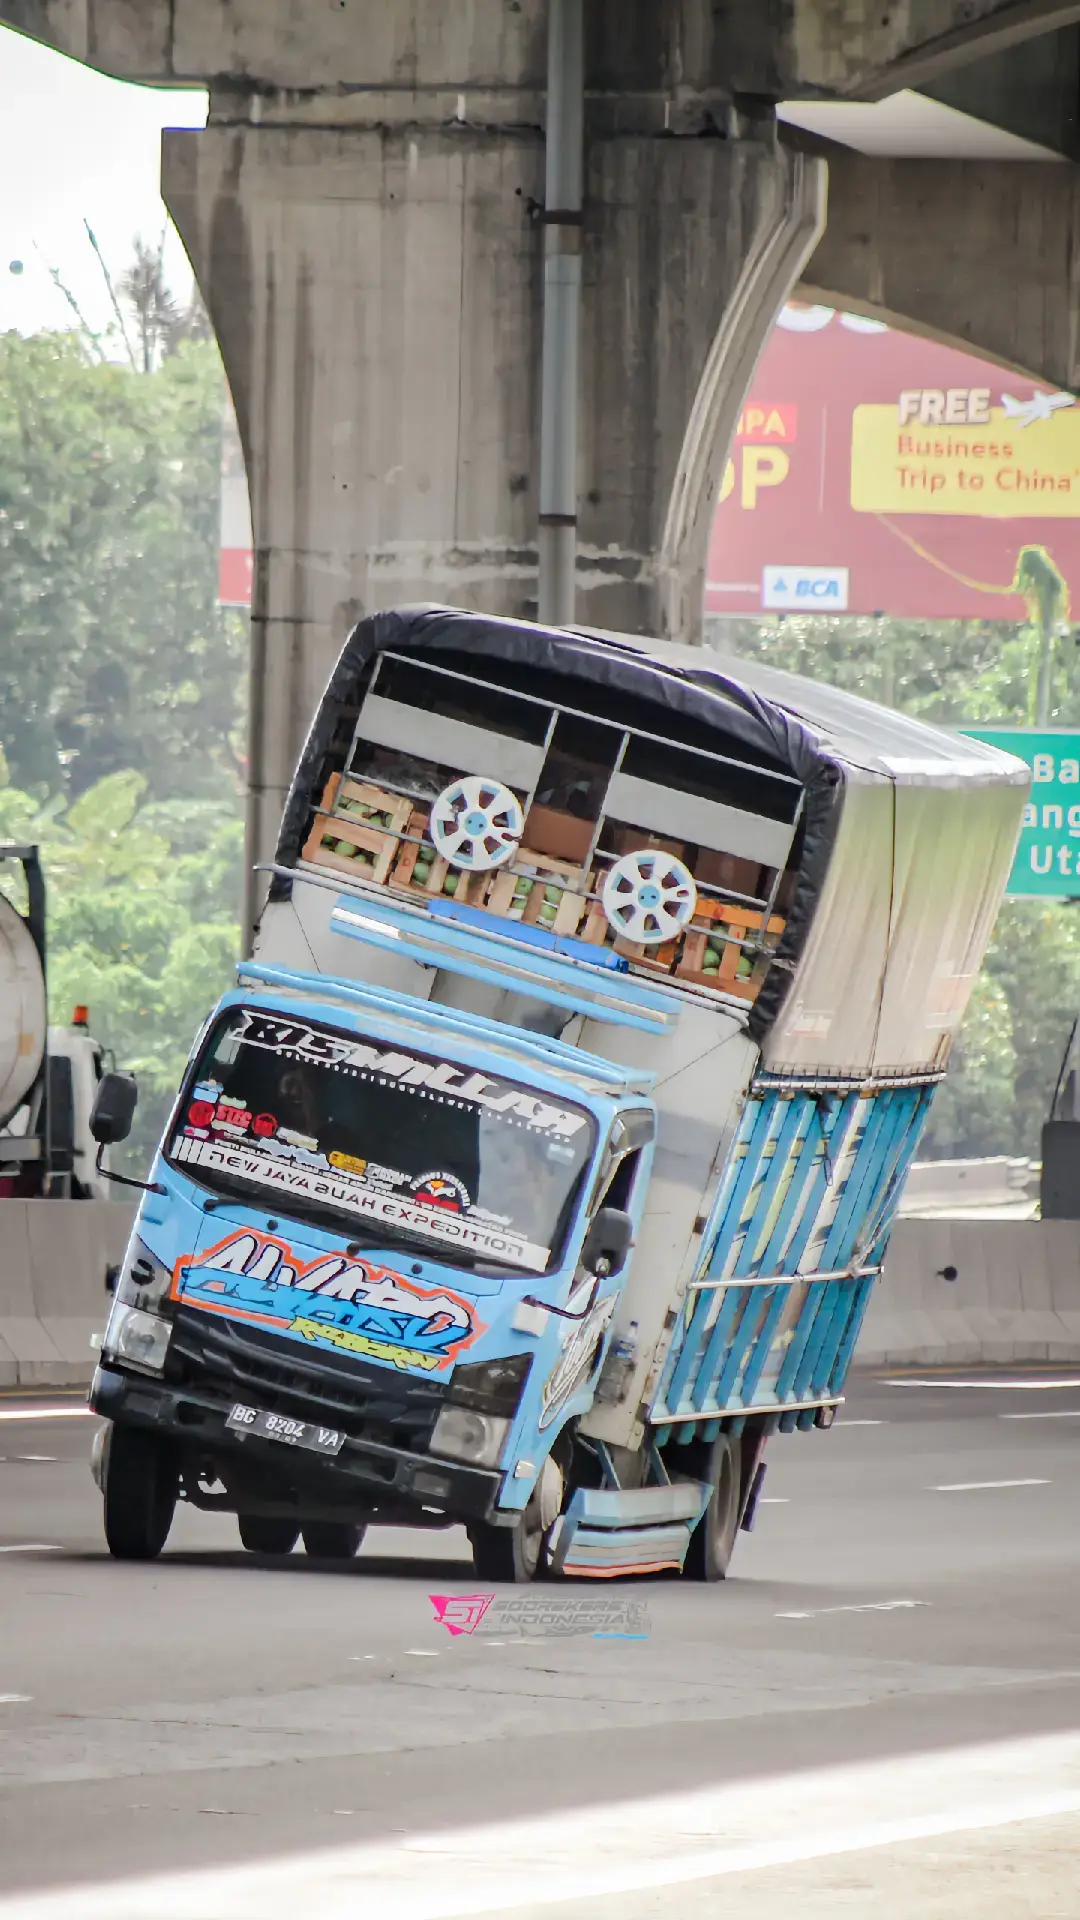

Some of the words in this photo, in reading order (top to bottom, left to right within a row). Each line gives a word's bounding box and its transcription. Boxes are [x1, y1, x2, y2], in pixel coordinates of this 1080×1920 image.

[899, 388, 991, 426] FREE
[736, 408, 786, 437] PA
[897, 434, 1012, 459] Business
[895, 465, 947, 494] Trip
[958, 468, 984, 491] to
[796, 579, 839, 598] BCA
[262, 1166, 310, 1191] JAYA
[314, 1180, 376, 1211] BUAH
[232, 1406, 257, 1424] BG
[265, 1415, 306, 1438] 8204
[317, 1428, 339, 1447] VA
